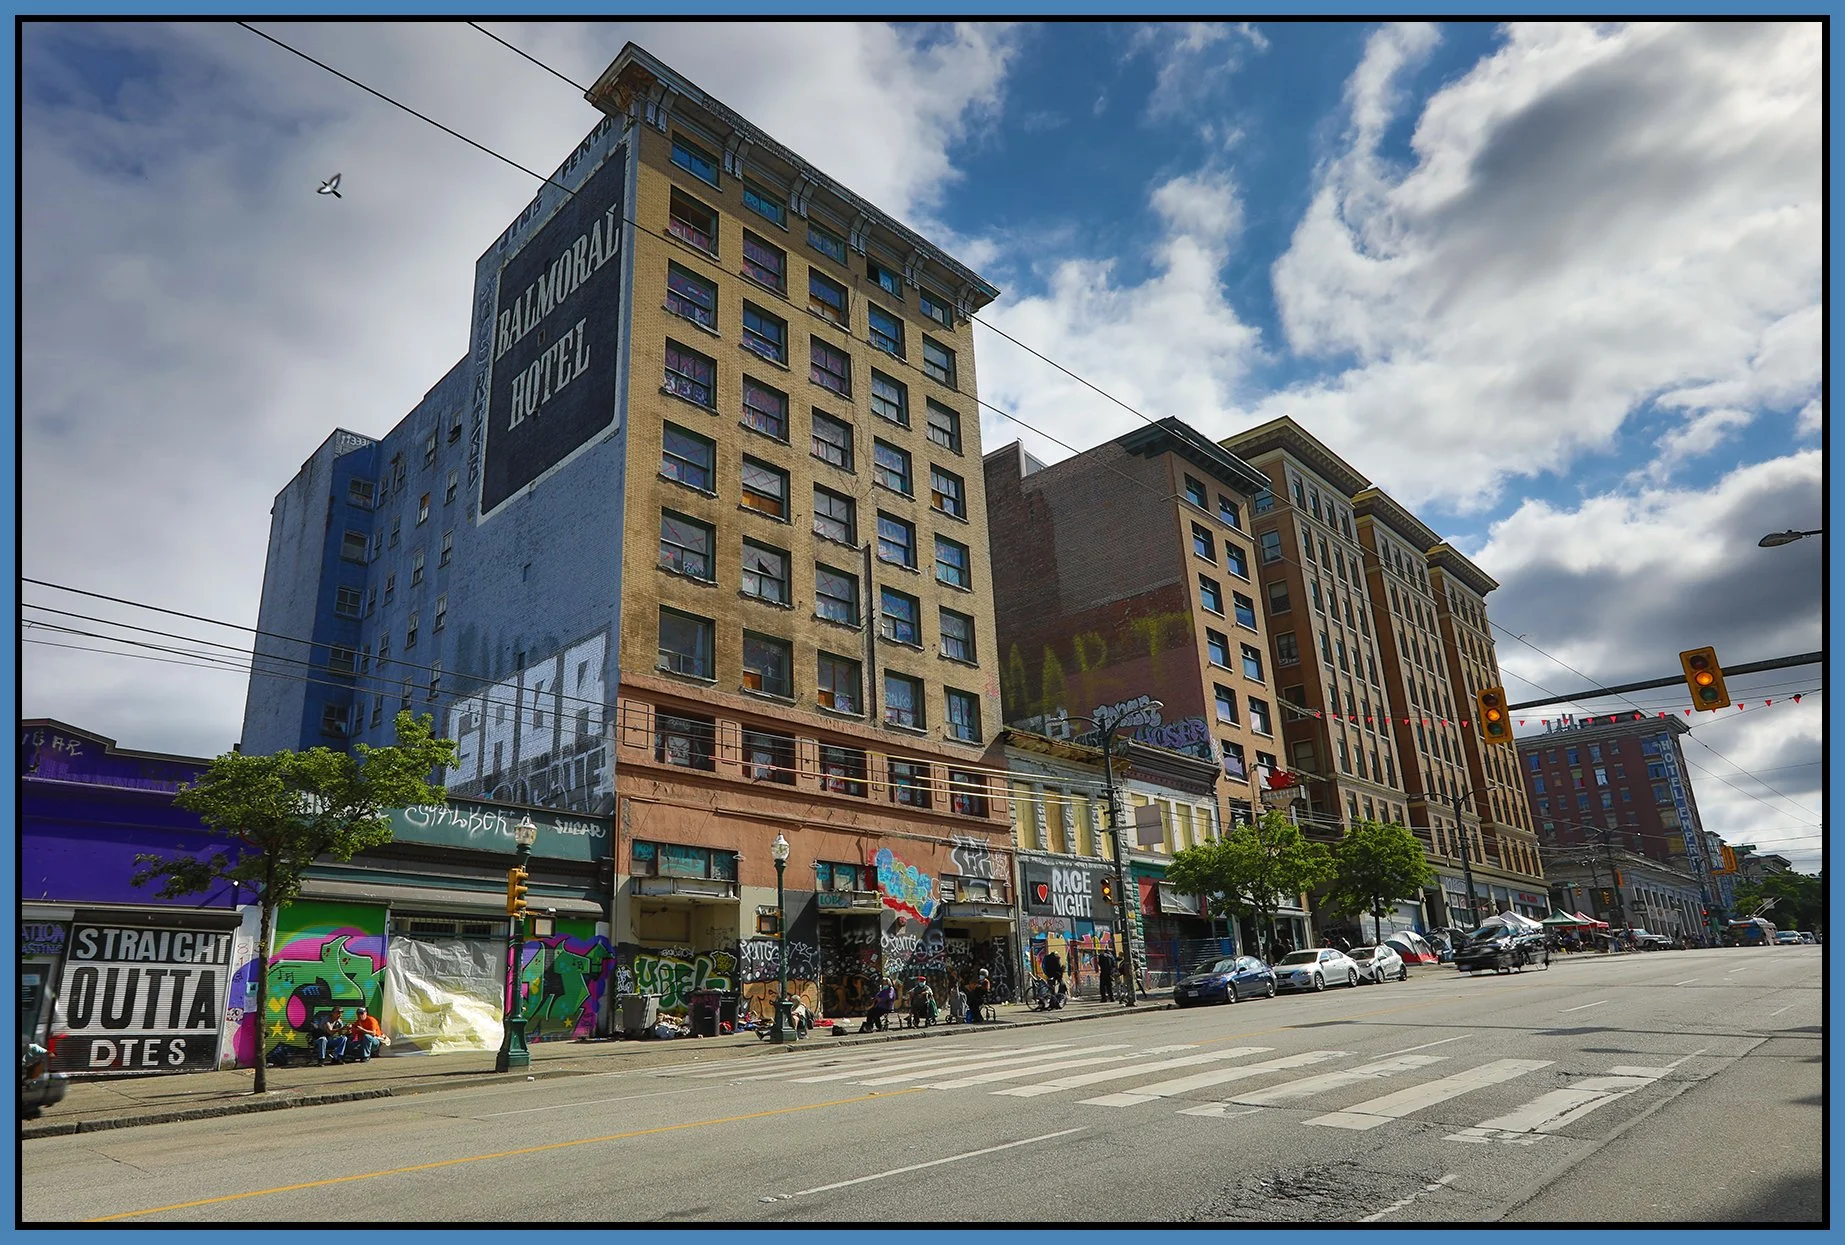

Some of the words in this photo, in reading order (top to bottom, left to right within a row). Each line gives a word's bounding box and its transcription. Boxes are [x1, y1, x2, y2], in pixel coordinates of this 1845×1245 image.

[495, 203, 620, 363] BALMORAL
[507, 317, 591, 432] HOTEL
[1661, 740, 1684, 800] HOTEL
[1052, 867, 1092, 894] RACE
[1052, 893, 1092, 918] NIGHT
[76, 928, 232, 964] STRAIGHT
[67, 966, 217, 1030] OUTTA
[88, 1038, 187, 1068] DTES
